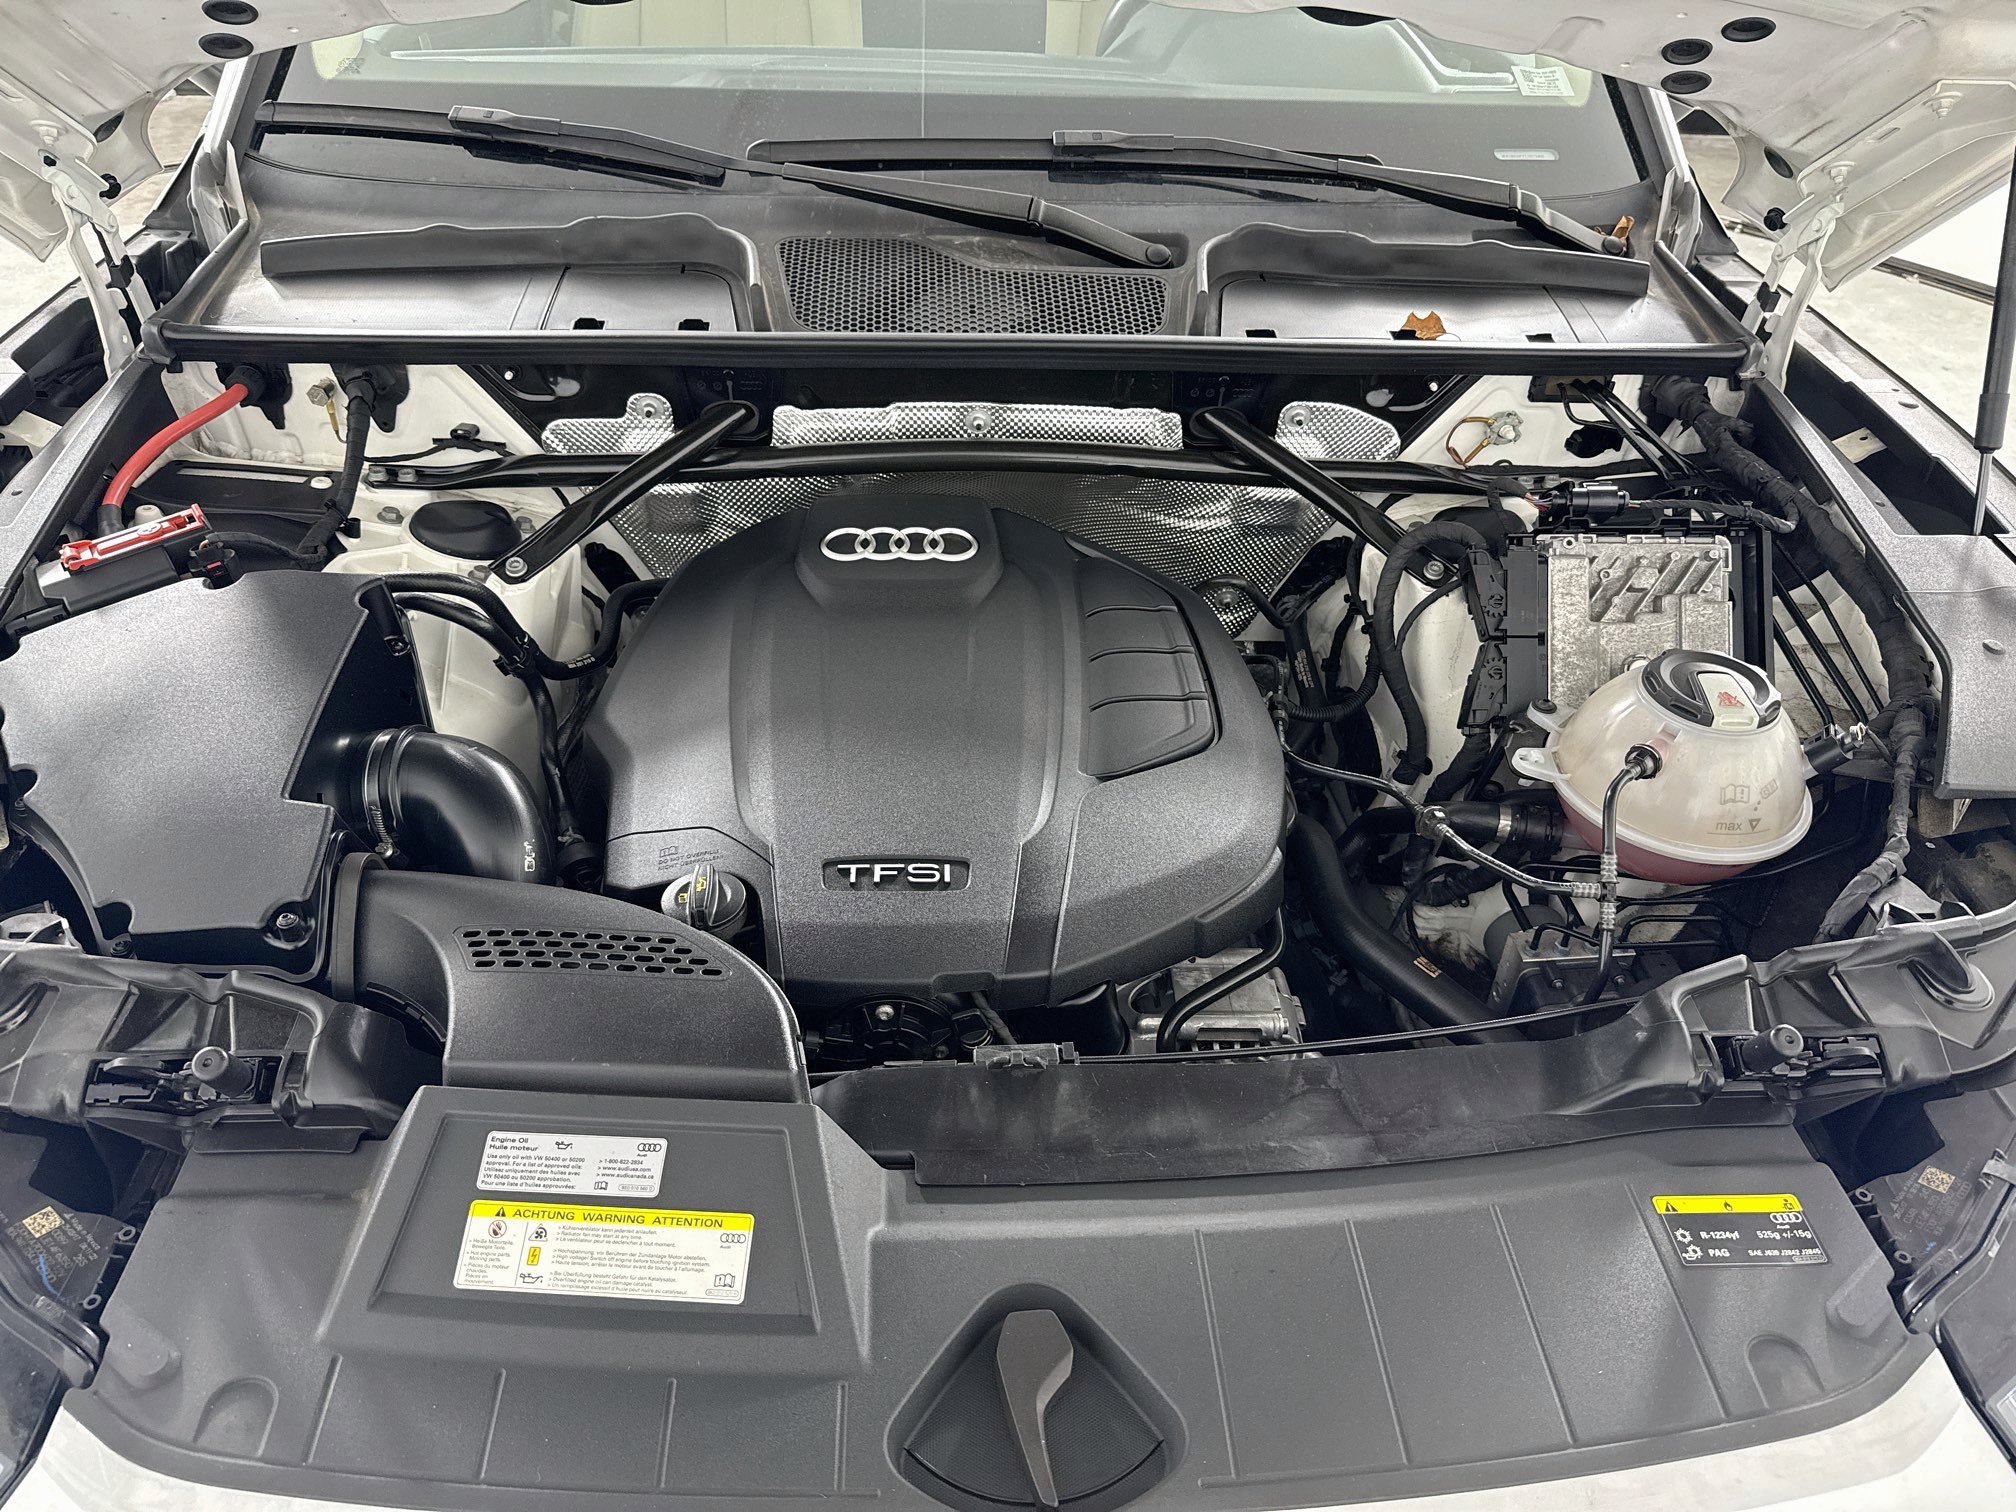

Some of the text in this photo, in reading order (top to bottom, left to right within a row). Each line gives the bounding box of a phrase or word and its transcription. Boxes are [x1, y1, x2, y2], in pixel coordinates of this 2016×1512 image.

[1715, 821, 1742, 831] max
[837, 864, 950, 882] TFSI
[512, 1209, 723, 1228] ACHTUNG WARNING ATTENTION
[1700, 1230, 1812, 1240] R-1234yf 525g +/-15g
[1708, 1249, 1730, 1257] PAG
